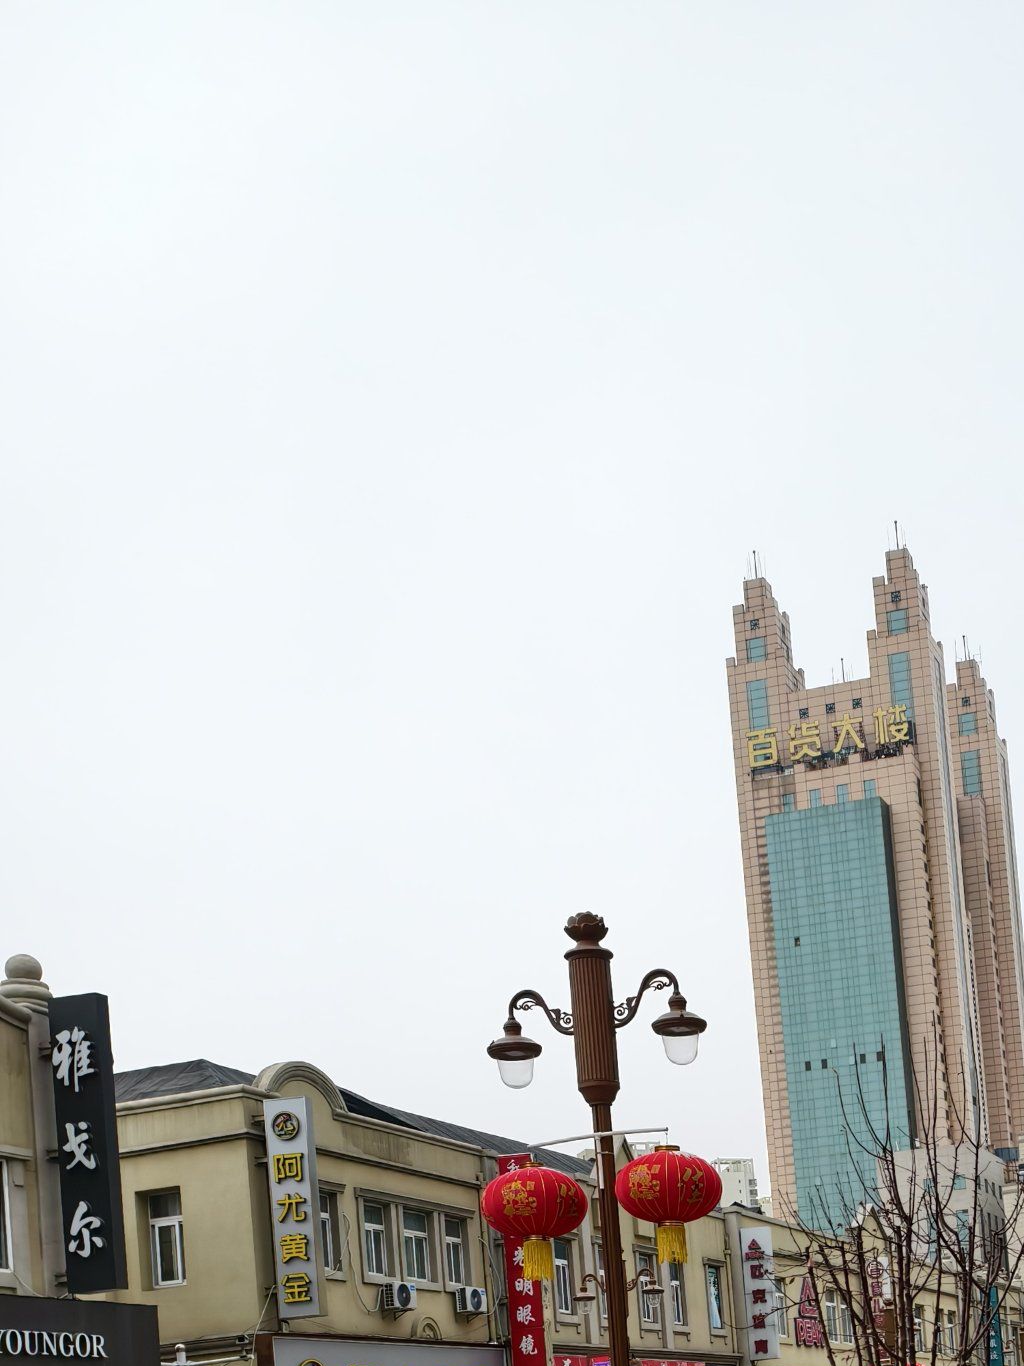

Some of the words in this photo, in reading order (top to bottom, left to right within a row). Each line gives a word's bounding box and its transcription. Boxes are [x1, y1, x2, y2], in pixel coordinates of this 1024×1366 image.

[745, 704, 910, 768] 百货大楼
[52, 1026, 104, 1258] 雅戈尔
[273, 1153, 312, 1305] 阿尤黄金
